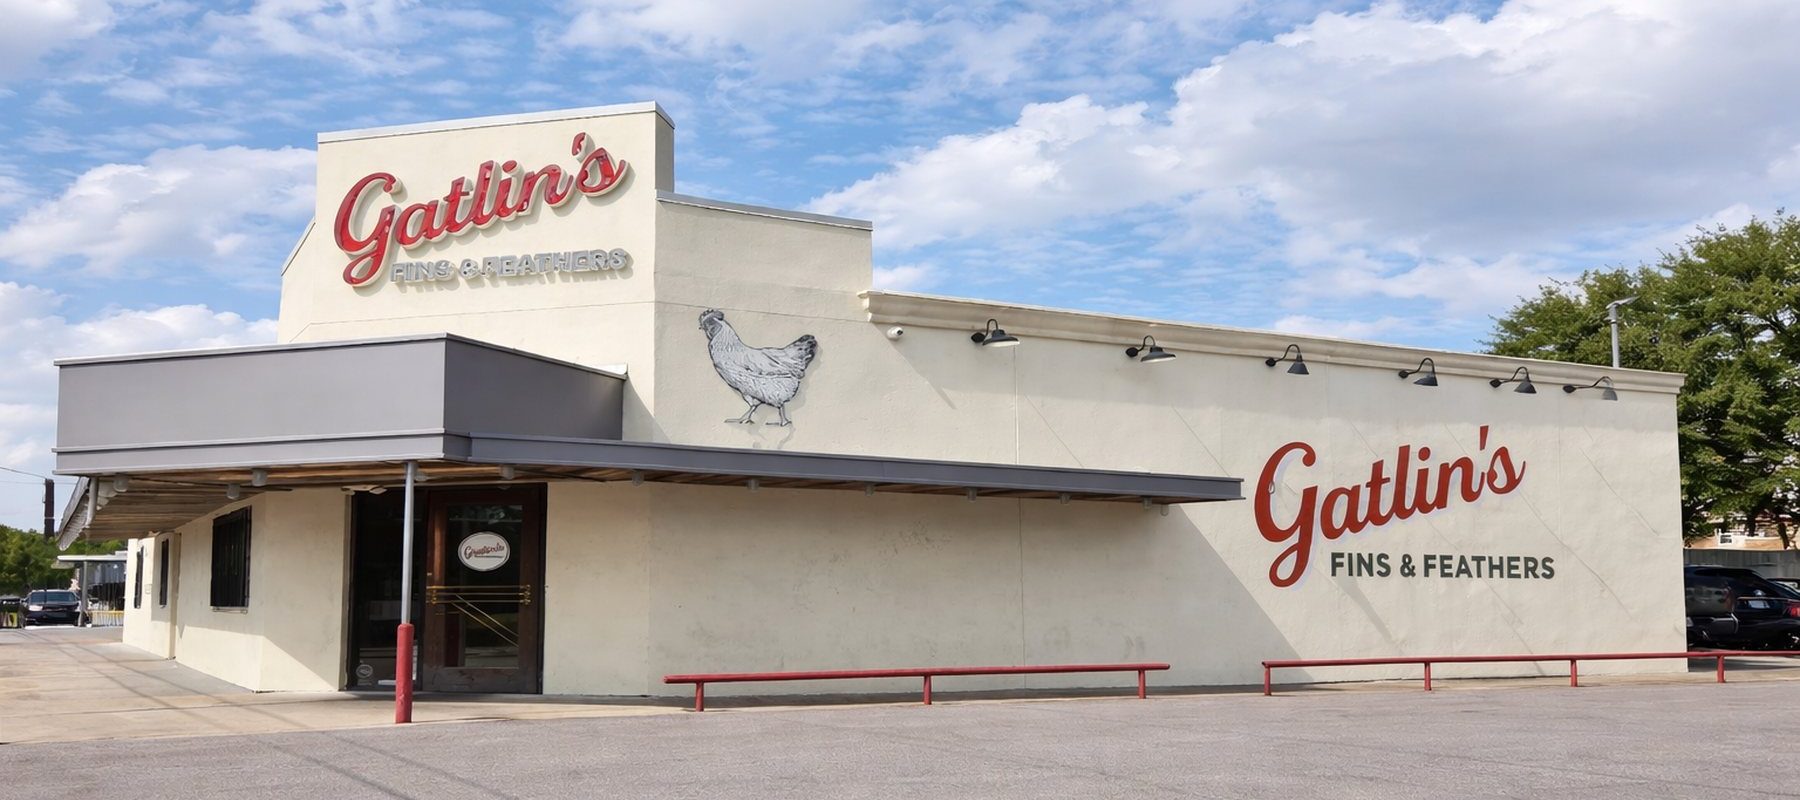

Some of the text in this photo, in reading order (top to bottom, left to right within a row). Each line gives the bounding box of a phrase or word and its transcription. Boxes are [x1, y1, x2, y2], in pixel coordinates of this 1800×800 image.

[334, 132, 629, 287] Gatlin's
[390, 261, 454, 283] FINS
[460, 258, 480, 279] &
[1254, 425, 1526, 588] Gatlin's
[1331, 552, 1555, 579] FINS & FEATHERS
